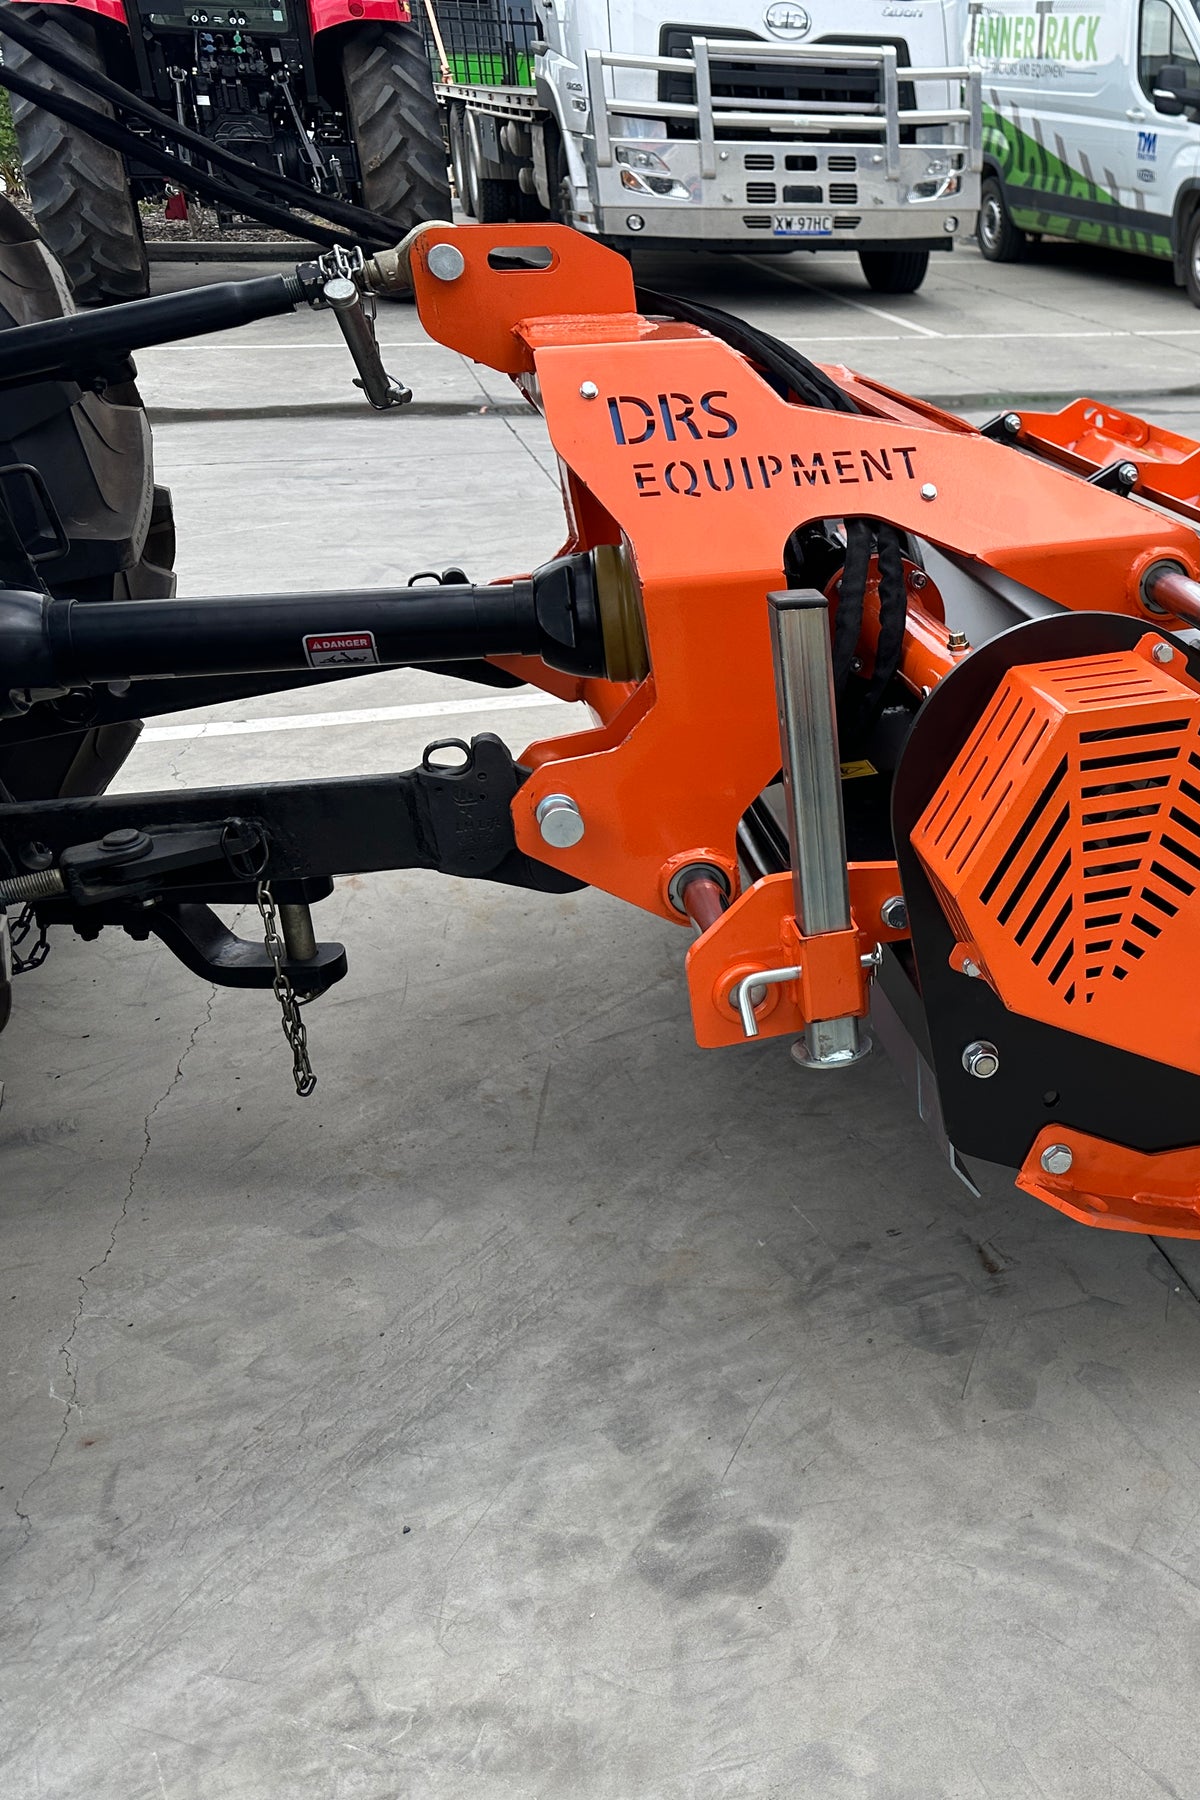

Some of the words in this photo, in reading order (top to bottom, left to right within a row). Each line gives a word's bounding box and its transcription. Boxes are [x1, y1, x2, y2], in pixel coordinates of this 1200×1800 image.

[606, 390, 738, 445] DRS
[632, 446, 917, 498] EQUIPMENT
[322, 638, 368, 649] DANGER
